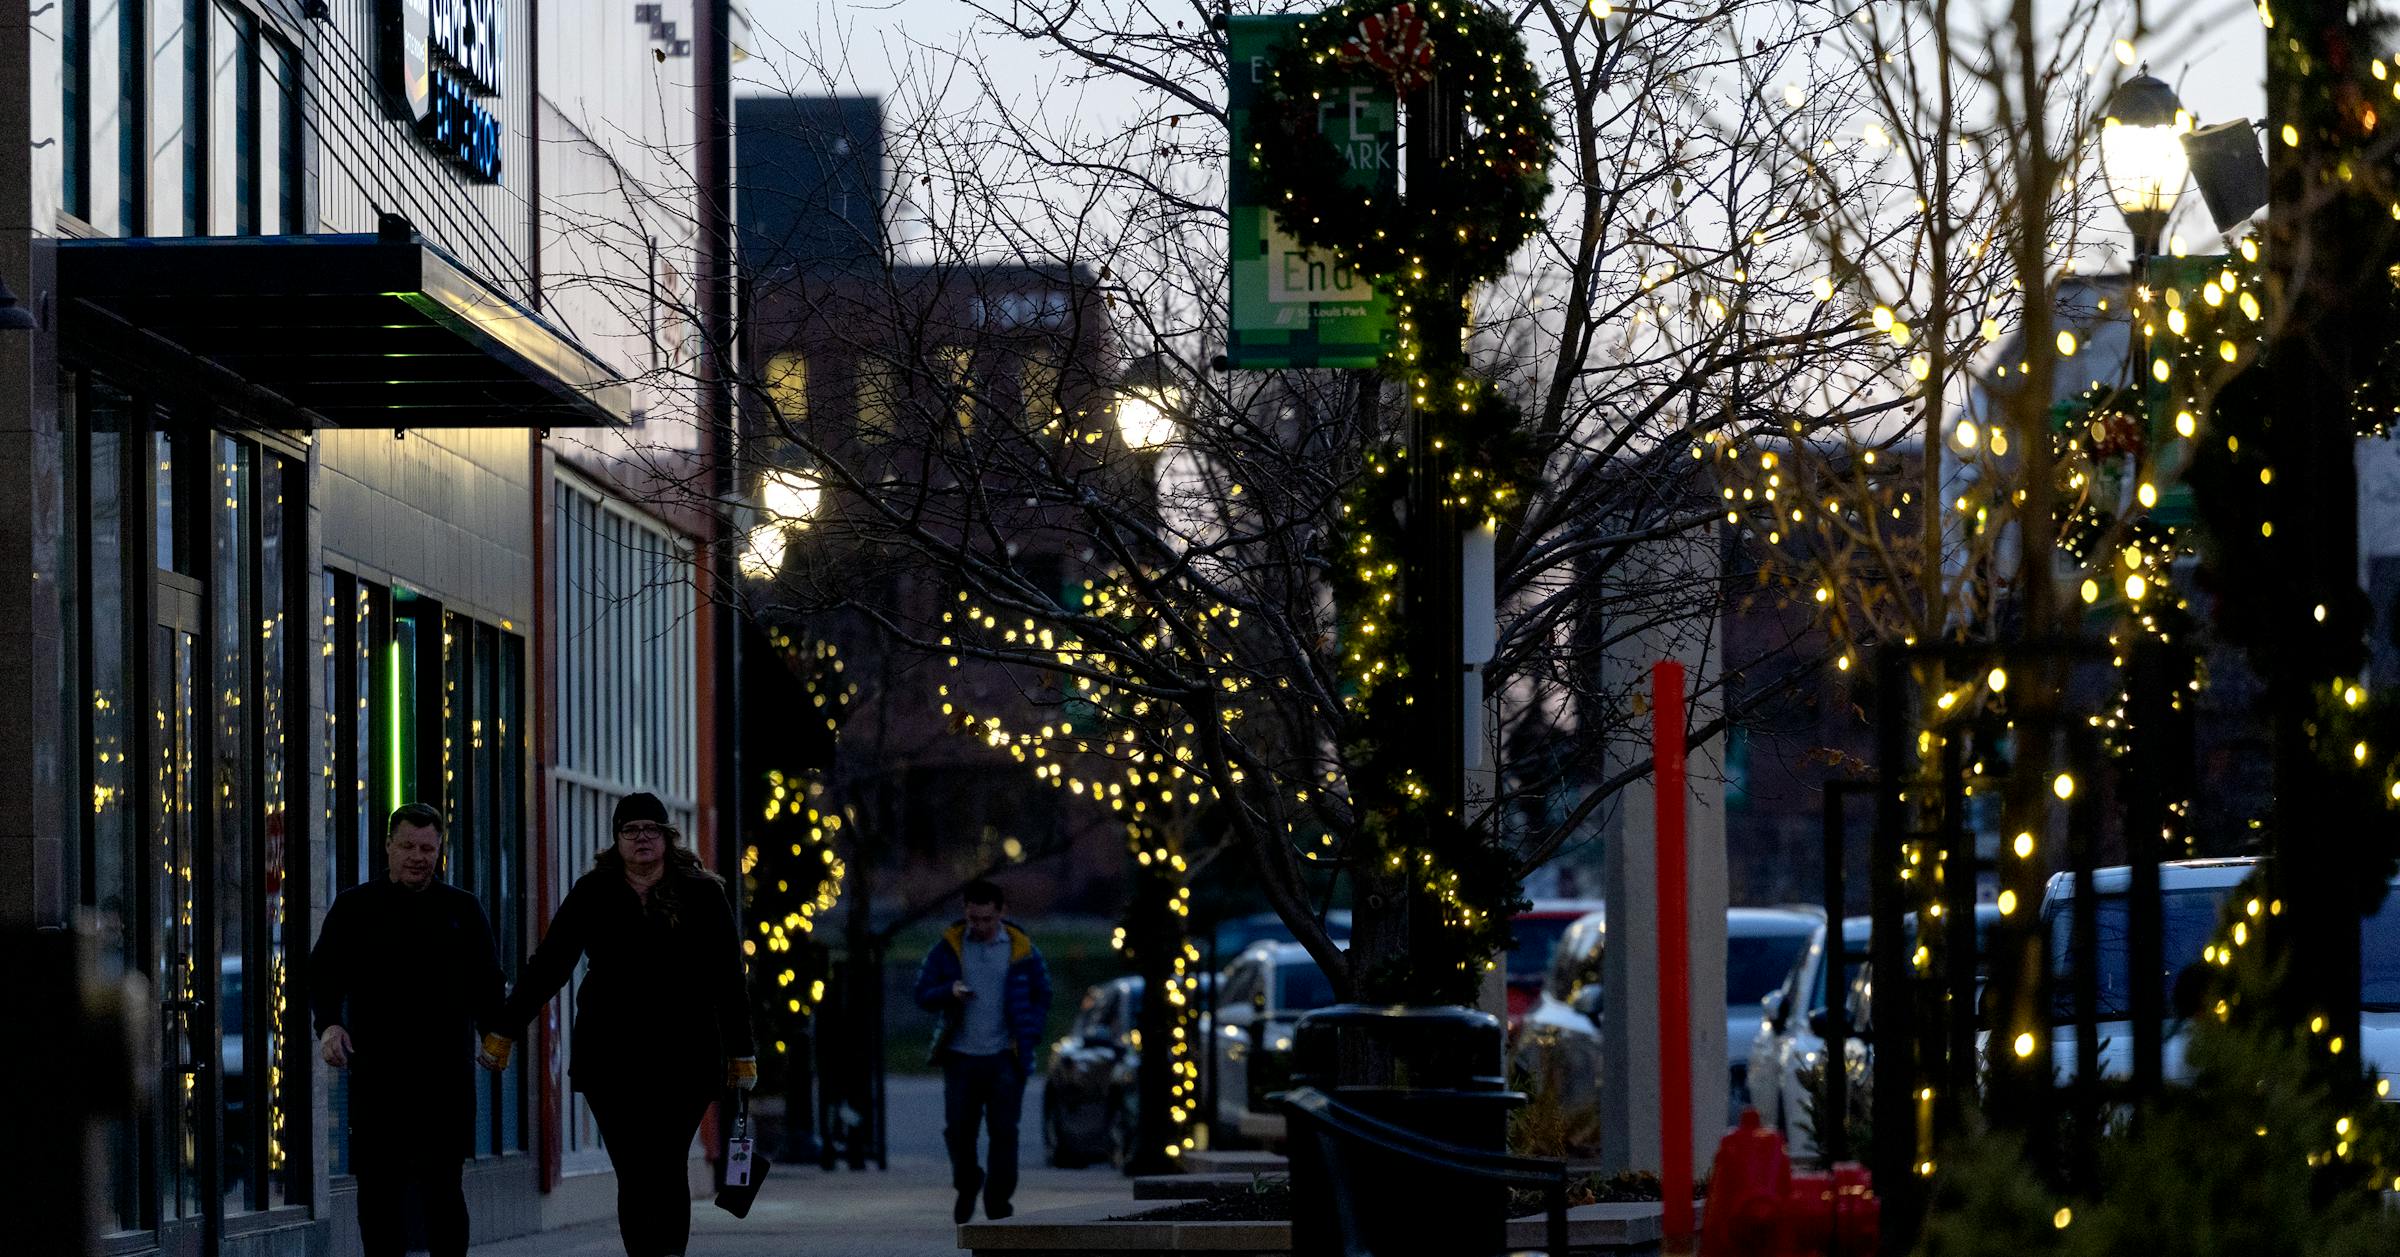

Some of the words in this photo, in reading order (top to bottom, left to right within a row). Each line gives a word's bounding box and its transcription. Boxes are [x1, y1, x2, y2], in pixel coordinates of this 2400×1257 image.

[471, 0, 503, 97] SHOW
[1334, 142, 1391, 169] ARK
[1283, 251, 1353, 292] End
[1342, 305, 1367, 317] Park
